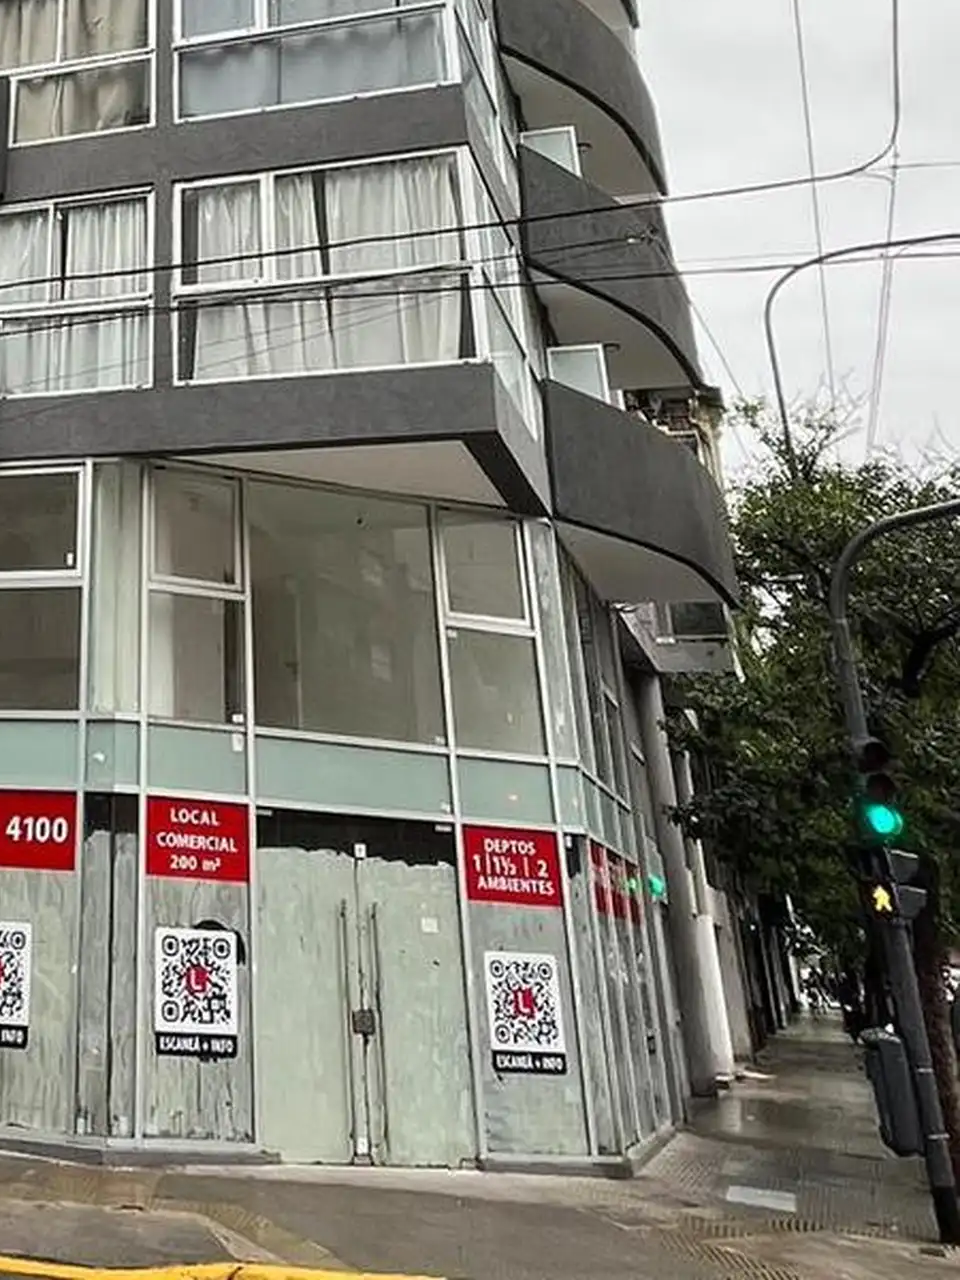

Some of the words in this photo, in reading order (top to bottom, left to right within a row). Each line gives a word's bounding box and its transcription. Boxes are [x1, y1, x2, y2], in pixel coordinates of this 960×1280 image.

[170, 807, 220, 826] LOCAL
[5, 816, 69, 843] 4100
[156, 832, 238, 853] COMERCIAL
[484, 838, 536, 855] DEPTOS
[170, 854, 197, 871] 200
[473, 854, 481, 873] 1
[537, 859, 548, 878] 2
[477, 875, 555, 896] AMBIENTES
